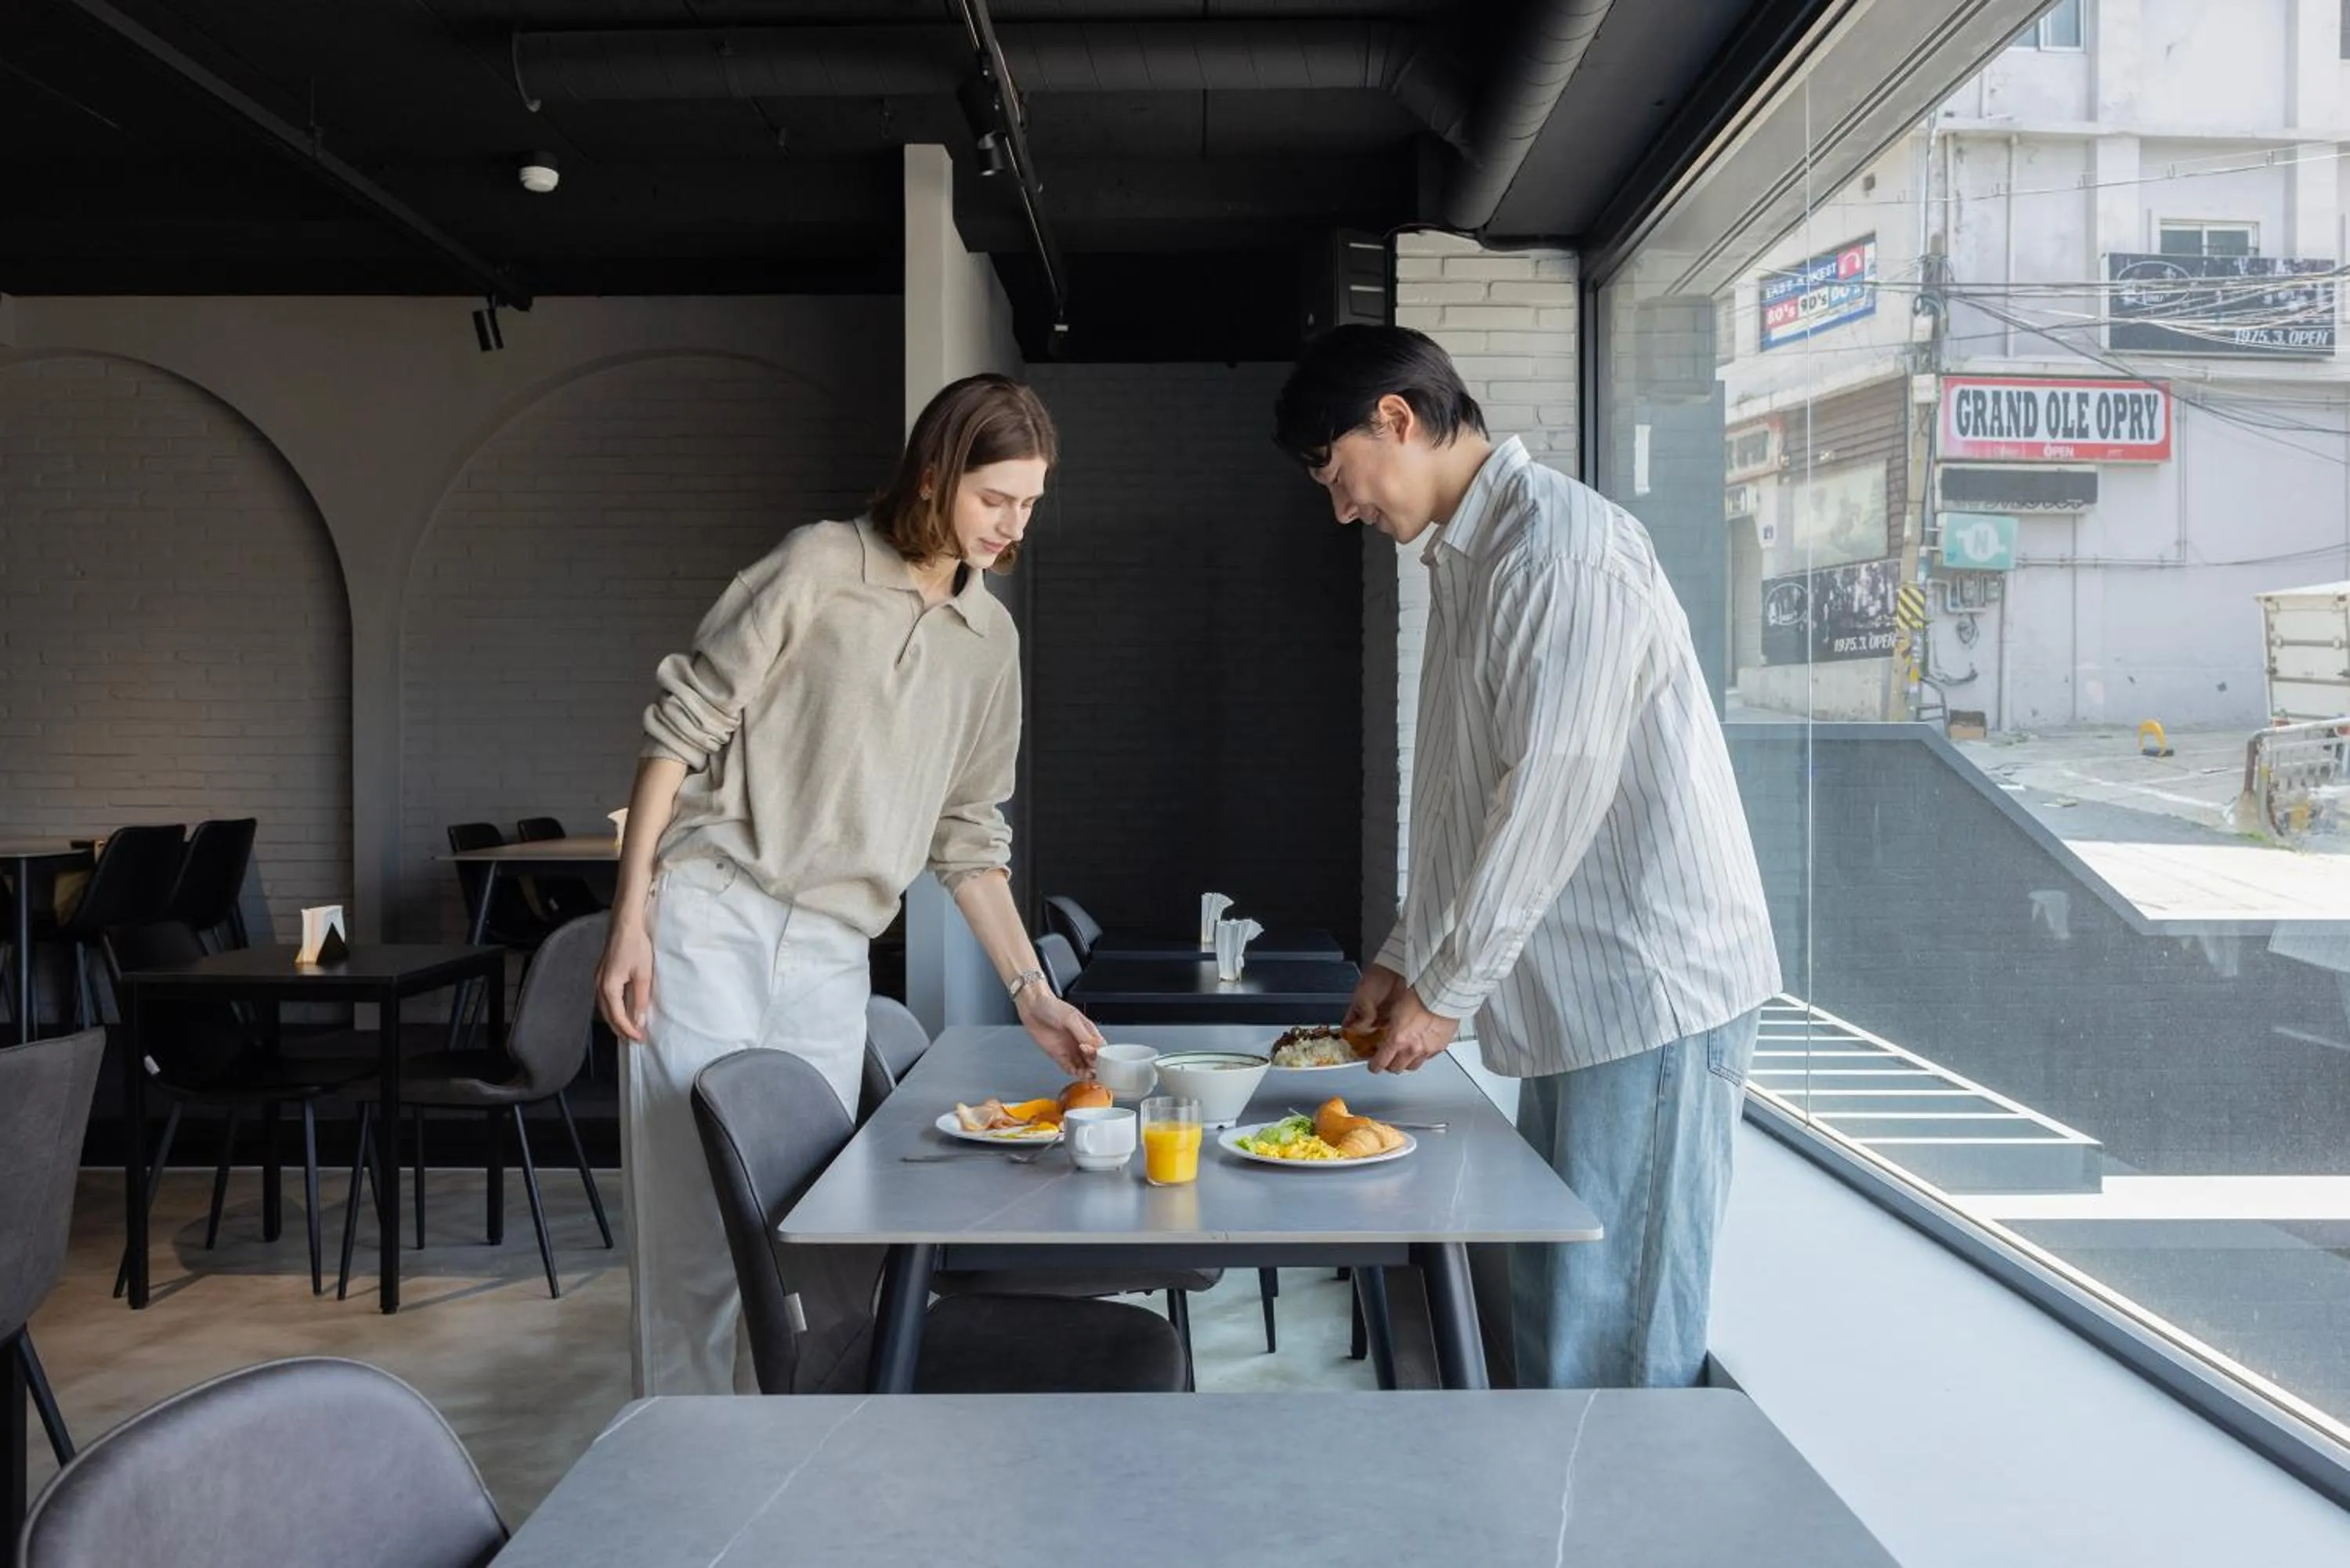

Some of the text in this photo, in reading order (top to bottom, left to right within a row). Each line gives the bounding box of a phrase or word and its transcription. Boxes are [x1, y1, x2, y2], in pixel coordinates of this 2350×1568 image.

[1799, 292, 1828, 312] 90's
[1956, 388, 2159, 440] GRAND OLE OPRY
[2043, 444, 2073, 457] OPEN
